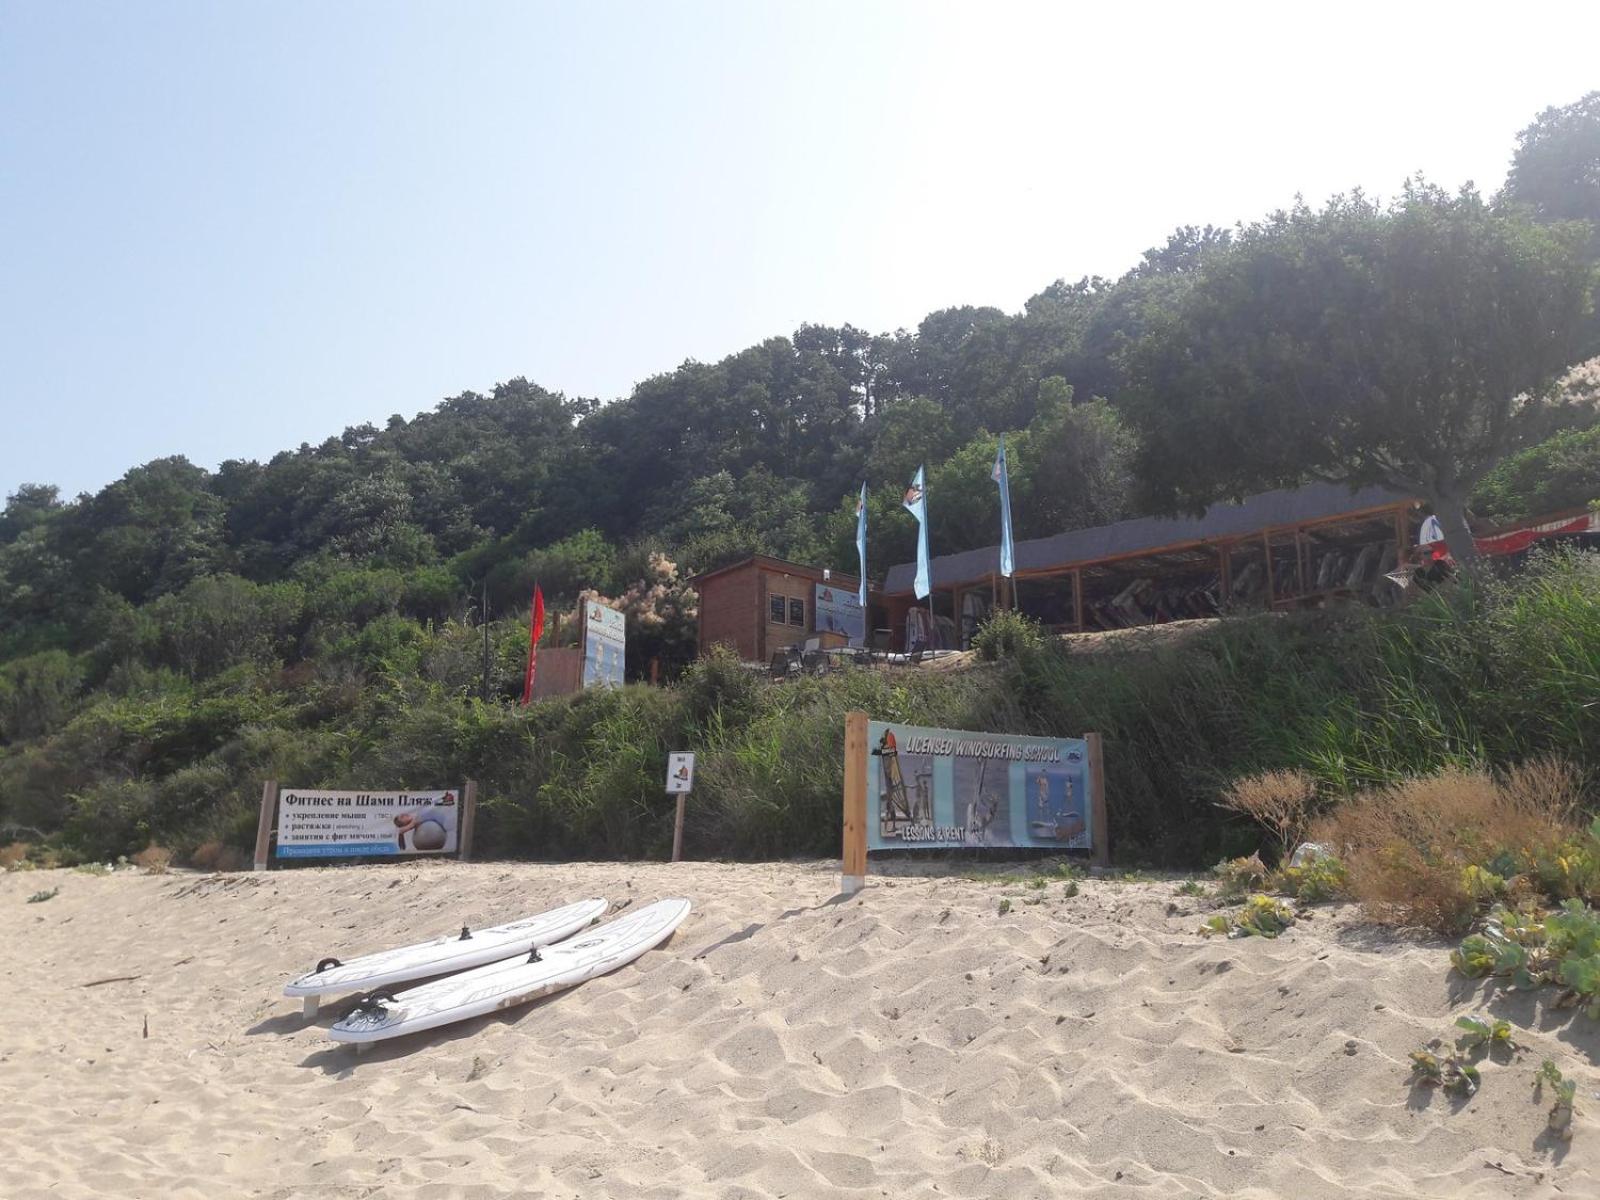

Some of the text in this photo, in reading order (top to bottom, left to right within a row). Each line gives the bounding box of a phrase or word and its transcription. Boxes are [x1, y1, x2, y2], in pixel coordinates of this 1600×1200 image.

[906, 735, 1061, 763] LICENSED WINDSURFING SCHOOL
[286, 793, 433, 806] Фитнес на Шами Пляж
[901, 825, 966, 841] LESSONS & RENT
